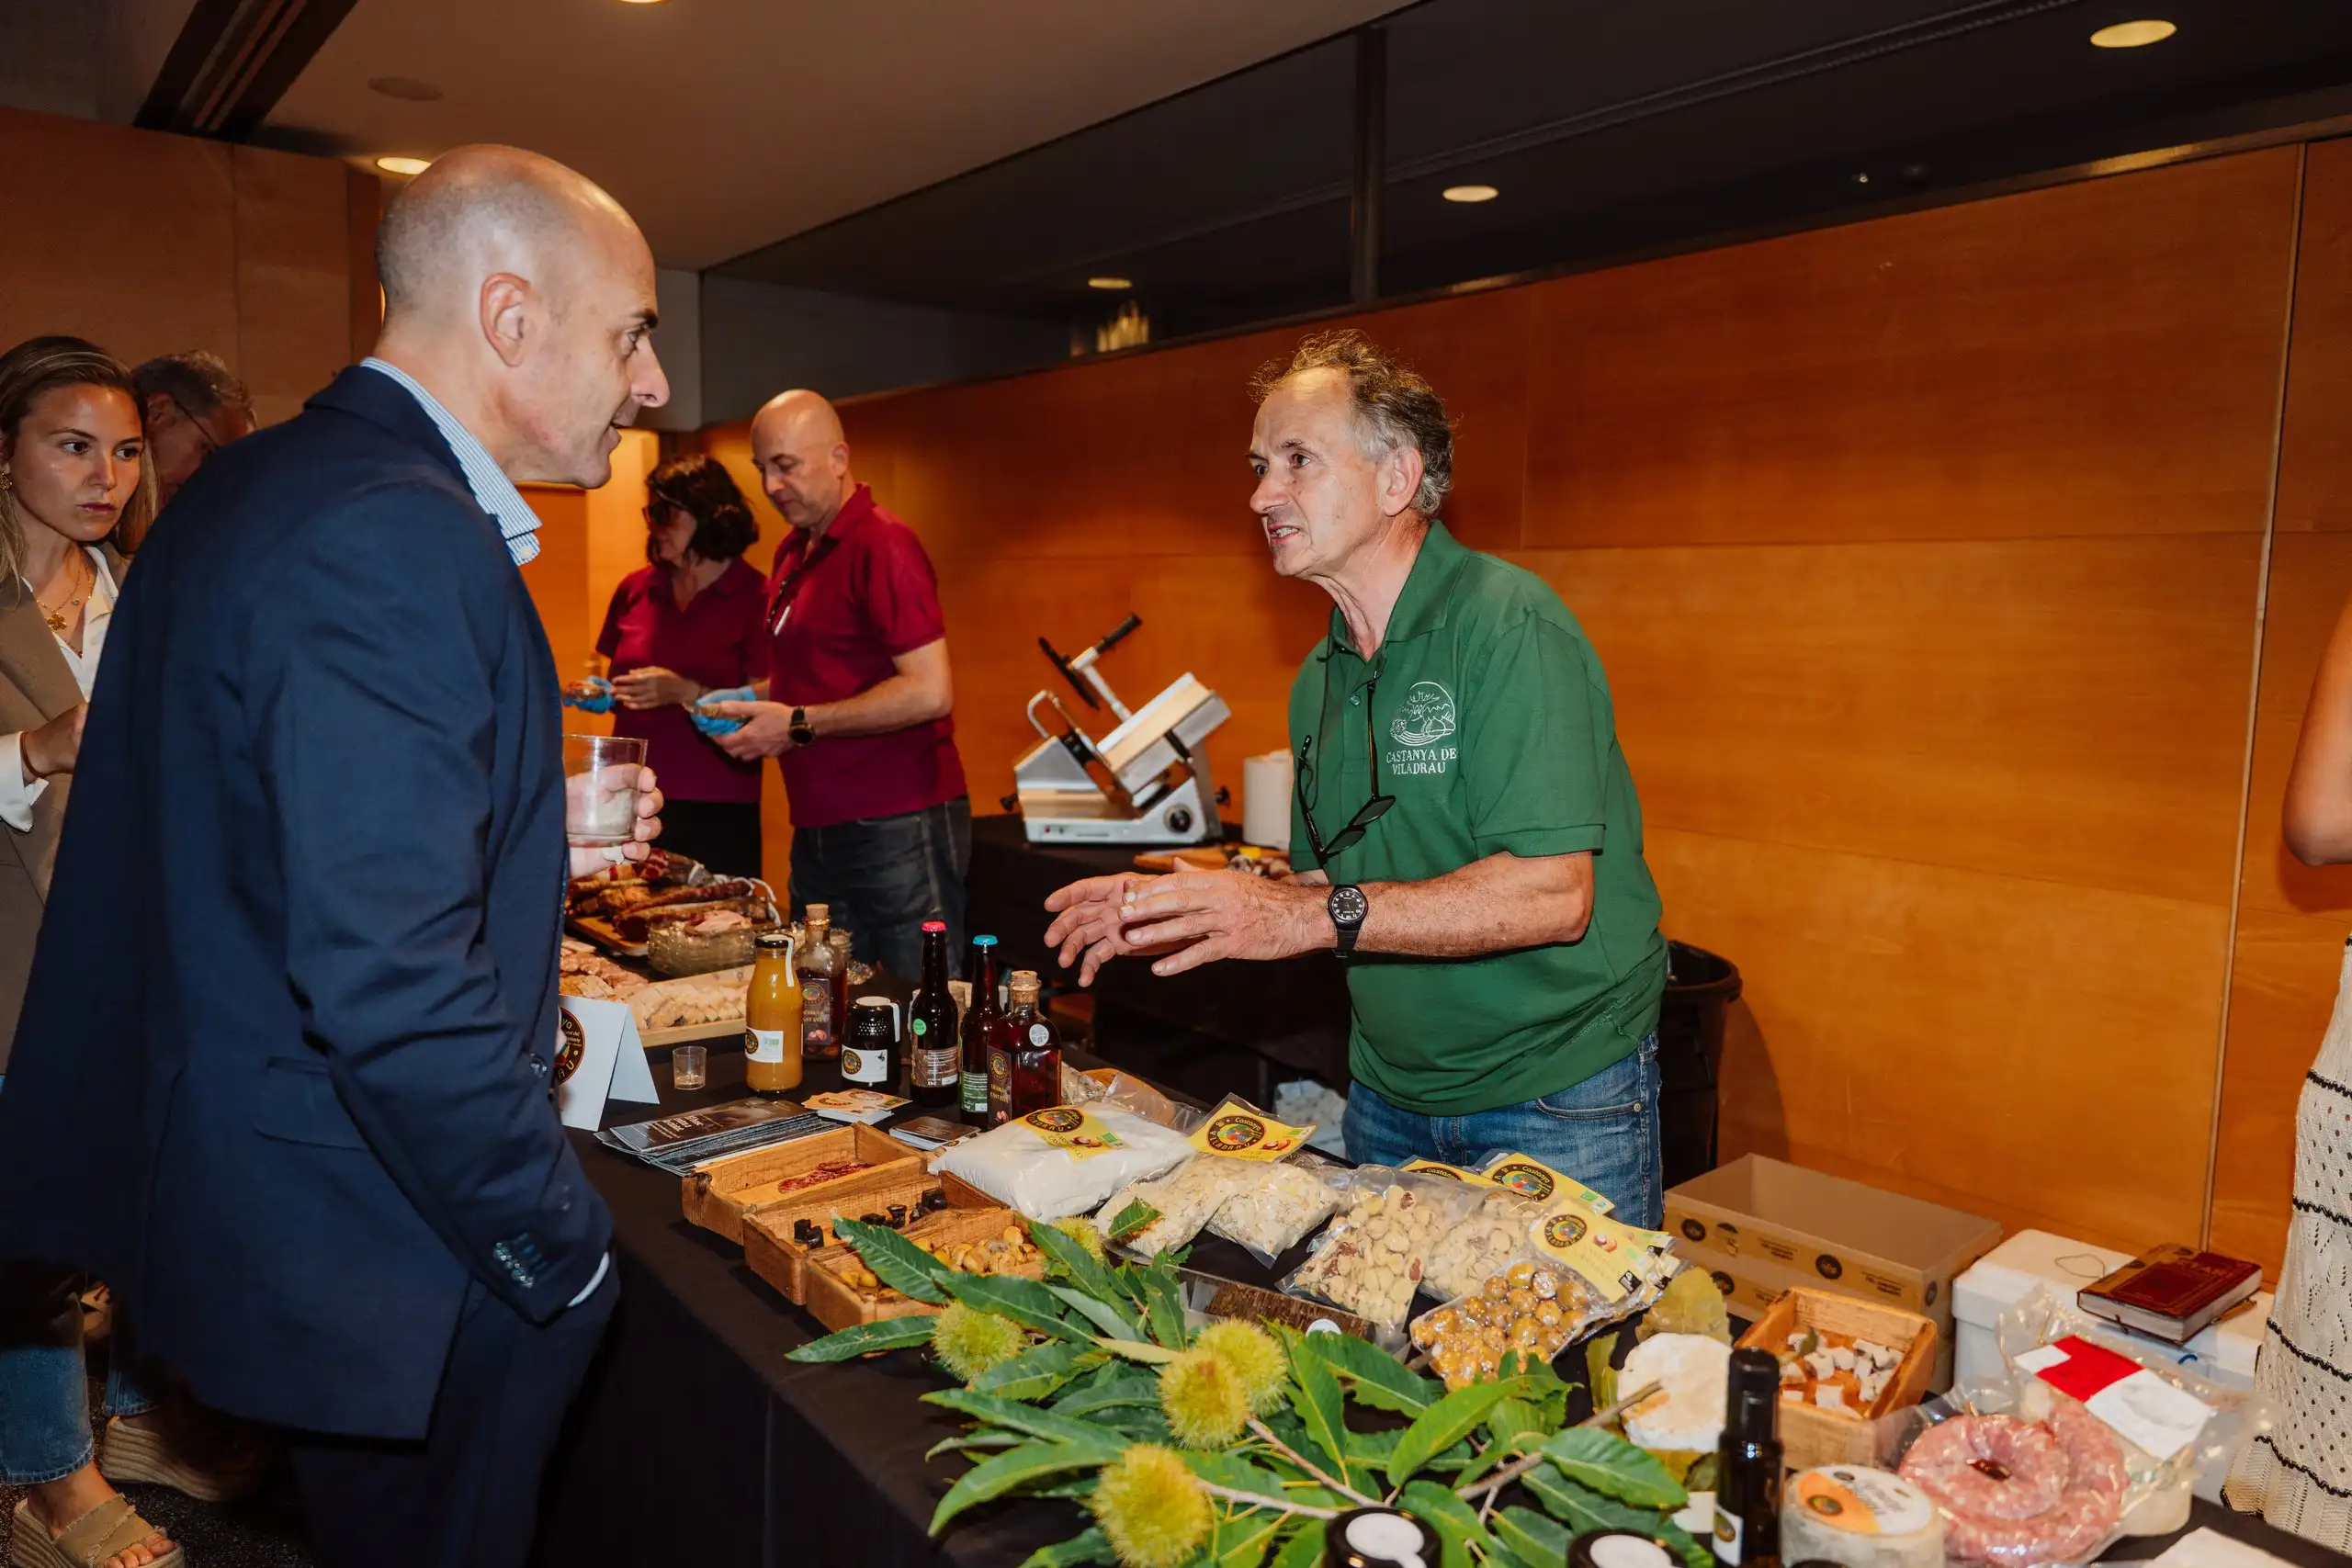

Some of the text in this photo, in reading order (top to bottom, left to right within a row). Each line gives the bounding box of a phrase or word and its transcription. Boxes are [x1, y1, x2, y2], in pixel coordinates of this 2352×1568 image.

[1386, 748, 1457, 763] CASTANYA DE
[1392, 761, 1446, 774] VILADRAU
[1235, 1117, 1261, 1132] Castanya
[1209, 1131, 1250, 1151] VILADRAU
[1521, 1166, 1551, 1183] Castanya
